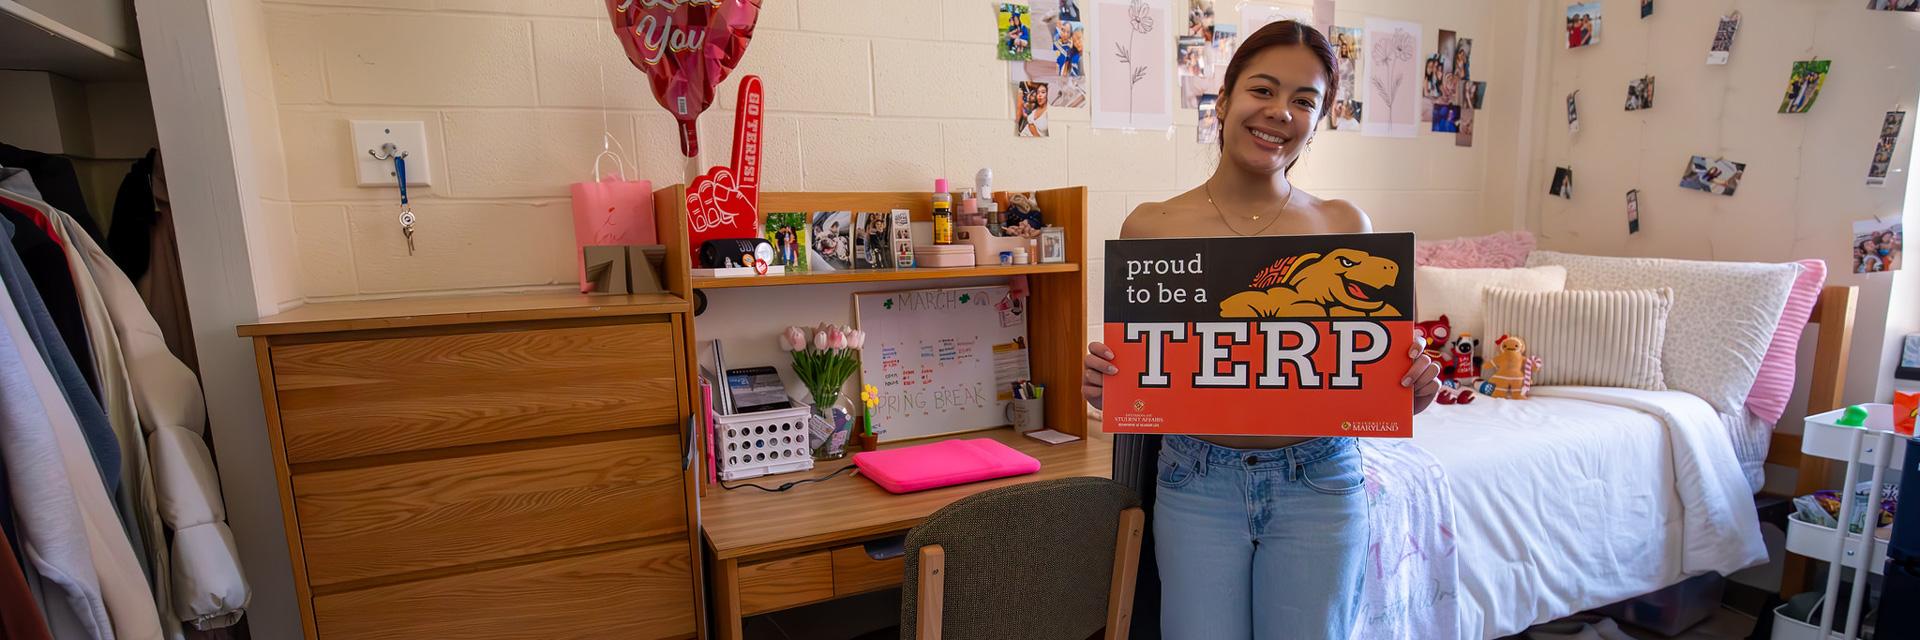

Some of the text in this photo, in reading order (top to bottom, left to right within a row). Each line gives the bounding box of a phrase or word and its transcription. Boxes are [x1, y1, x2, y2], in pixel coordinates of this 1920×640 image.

[635, 14, 706, 65] You
[743, 92, 760, 182] GO TERPS!
[1126, 253, 1203, 280] proud
[898, 291, 957, 312] MARCH
[1126, 282, 1208, 303] to be a
[1124, 320, 1392, 390] TERP
[934, 386, 986, 409] BREAK
